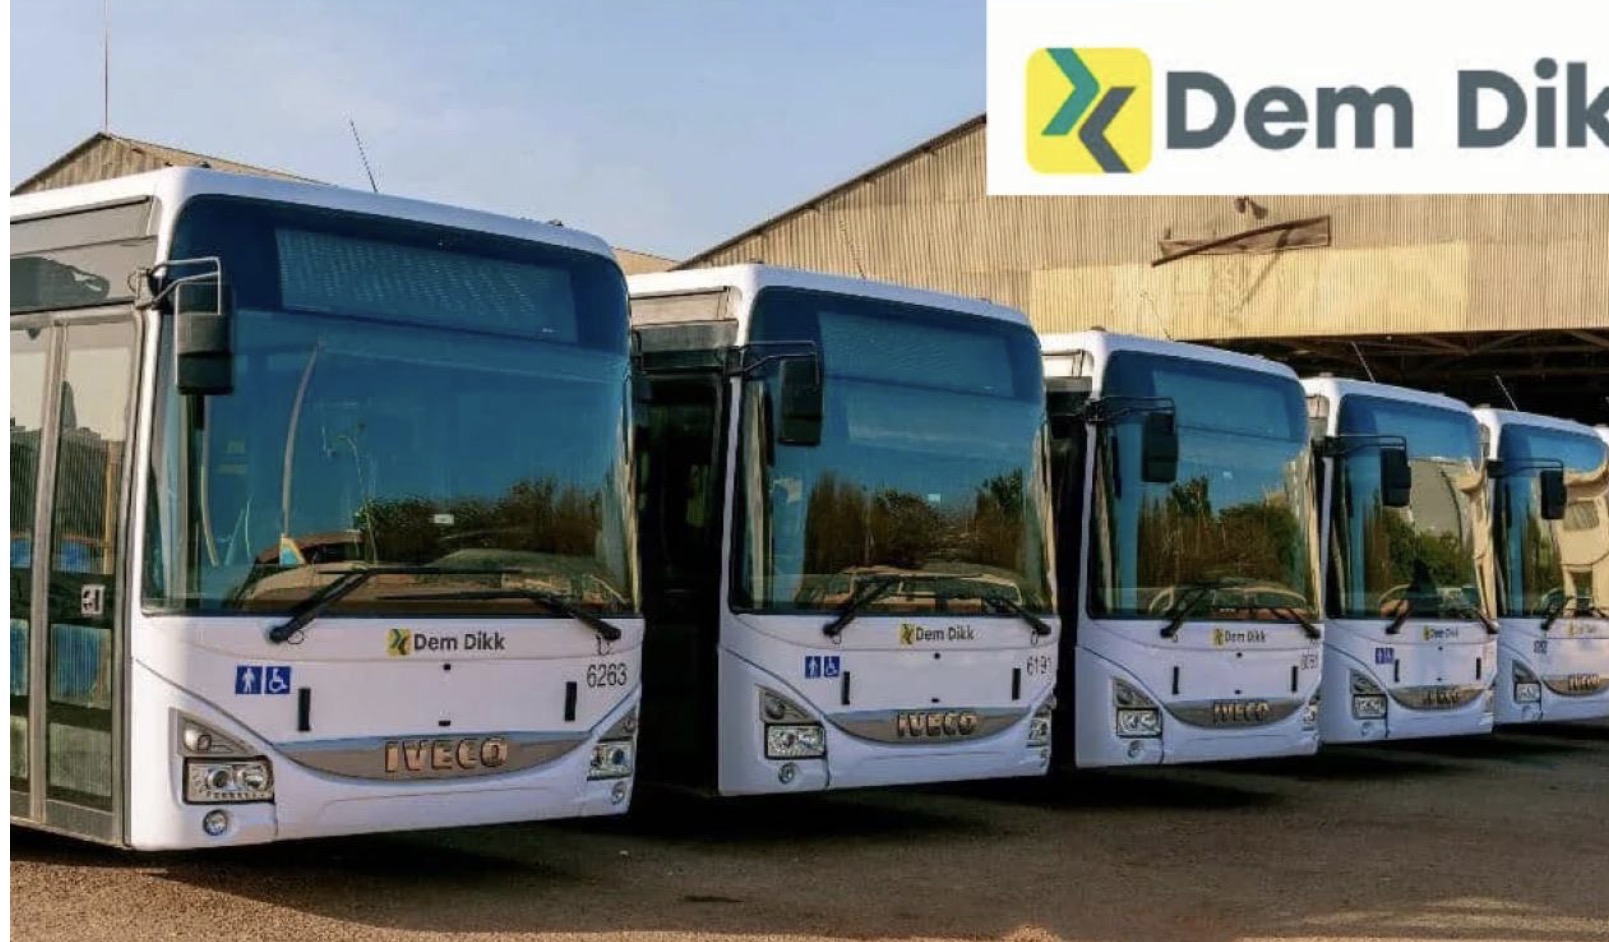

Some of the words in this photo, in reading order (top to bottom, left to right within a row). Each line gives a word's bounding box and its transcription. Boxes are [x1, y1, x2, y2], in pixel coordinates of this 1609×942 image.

[414, 633, 458, 652] Dem
[464, 631, 506, 651] Dikk
[914, 626, 945, 641] Dem
[948, 625, 975, 641] Dikk
[586, 663, 628, 687] 6263
[896, 711, 979, 738] IVECO
[384, 737, 508, 773] IVECO
